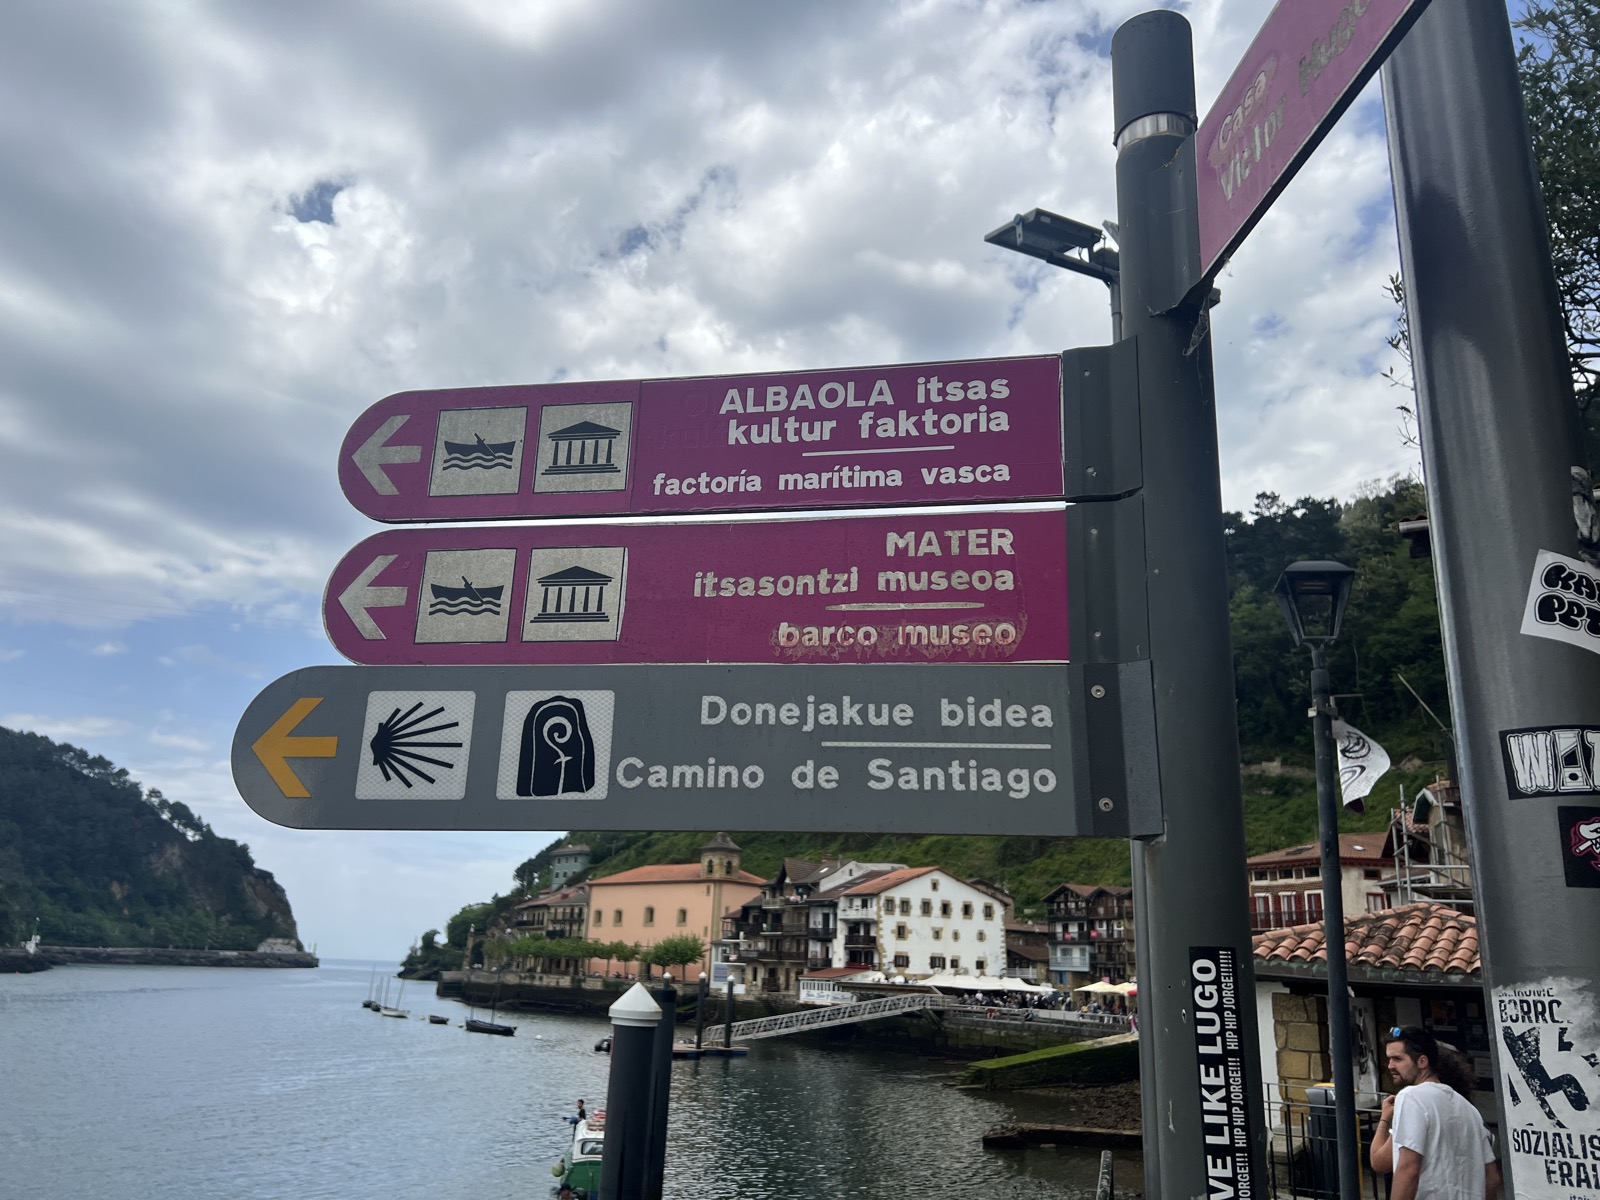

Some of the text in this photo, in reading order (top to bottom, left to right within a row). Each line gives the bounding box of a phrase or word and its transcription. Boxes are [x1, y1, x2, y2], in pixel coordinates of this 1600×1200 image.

[1219, 70, 1267, 151] Casa
[719, 376, 1011, 414] ALBAOLA itsas
[728, 405, 1011, 446] kultur faktoria
[653, 463, 1011, 496] factoría marítima vasca
[885, 528, 1016, 558] MATER
[693, 566, 1016, 598] itsasontzi museoa
[778, 621, 1018, 648] barco museo
[700, 695, 1054, 732] Donejakue bidea
[616, 757, 1057, 800] Camino de Santiago
[1192, 959, 1223, 1054] LUGO
[1223, 1010, 1237, 1029] HIP
[1225, 1031, 1239, 1050] HIP
[1227, 1057, 1243, 1105] JORGE!!!
[1200, 1064, 1230, 1145] LIKE
[1231, 1106, 1245, 1126] HIP
[1233, 1128, 1247, 1147] HIP
